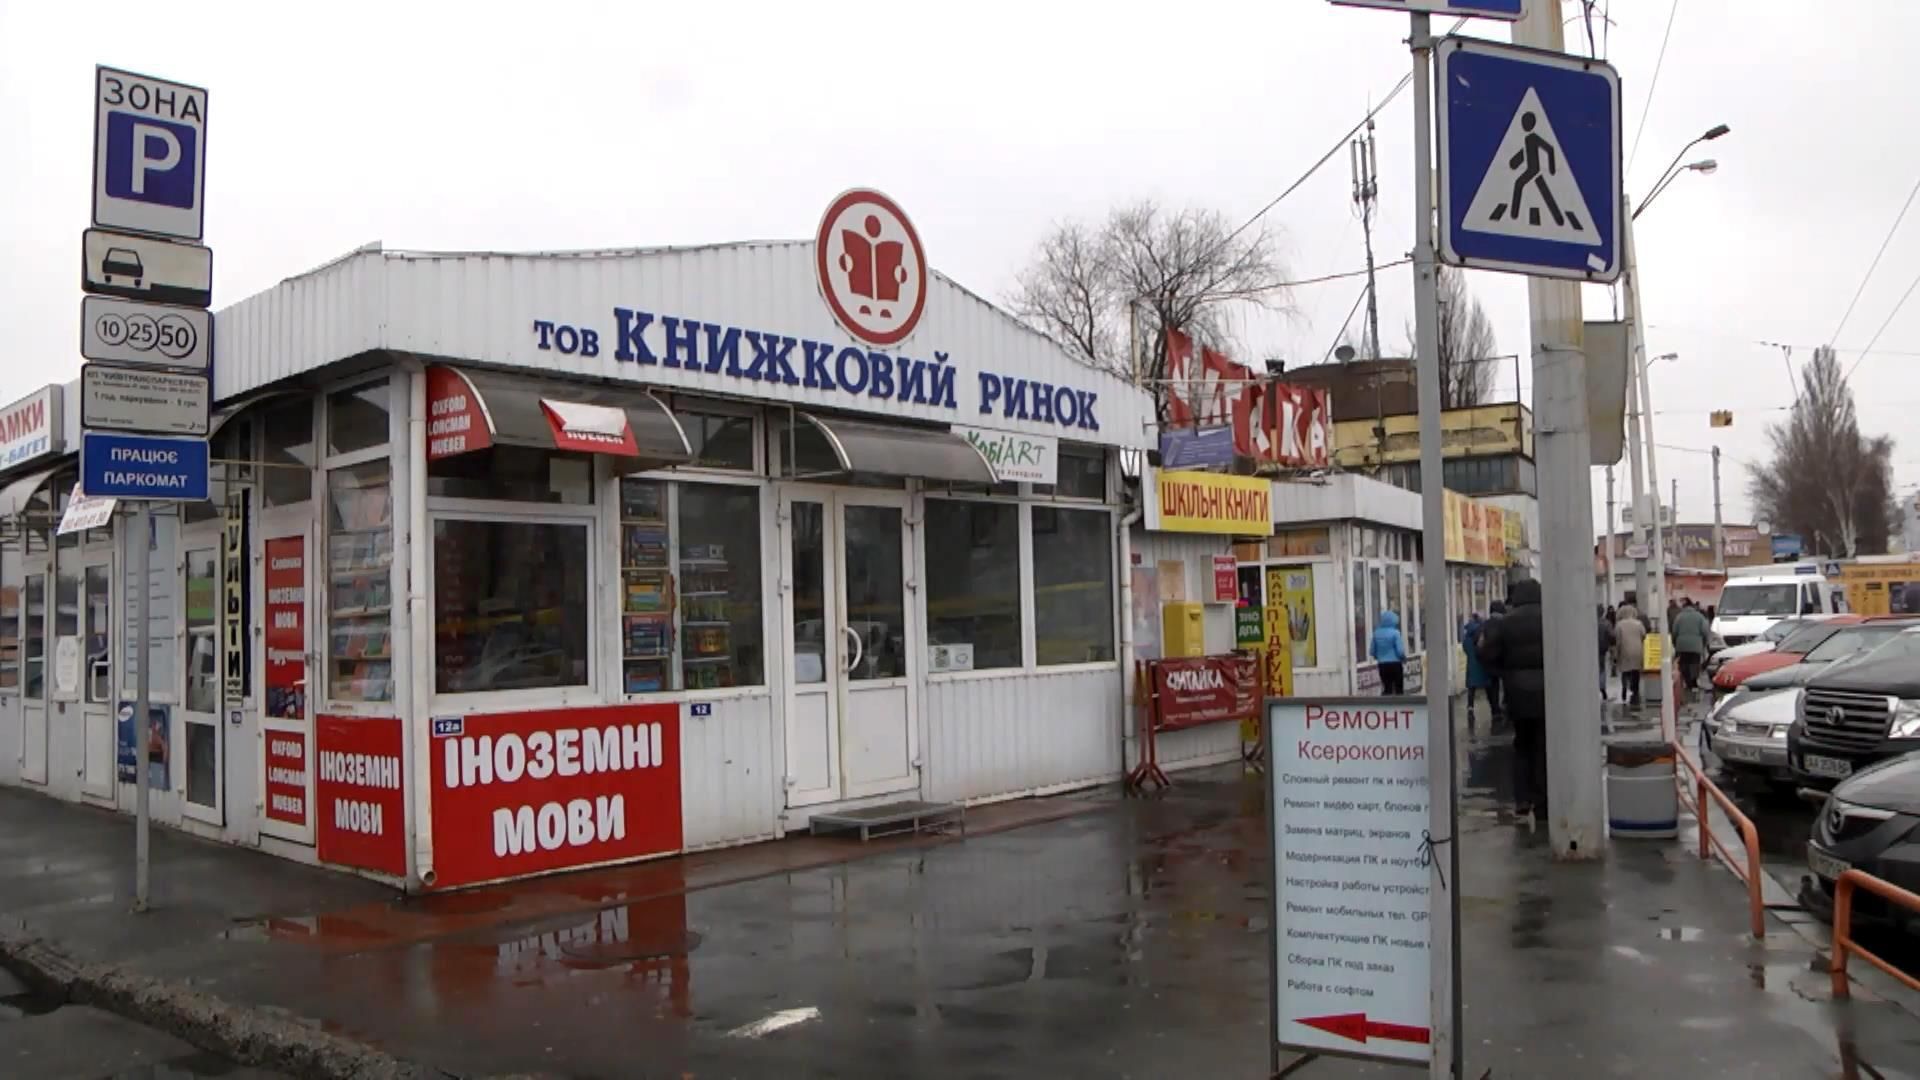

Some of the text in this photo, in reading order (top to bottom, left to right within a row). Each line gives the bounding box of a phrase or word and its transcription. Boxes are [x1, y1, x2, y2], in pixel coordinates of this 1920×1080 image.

[104, 77, 201, 122] ЗОНА
[131, 122, 181, 194] P
[102, 320, 190, 348] 10 25 50
[613, 307, 957, 409] КНИЖКОВИЙ
[978, 370, 1099, 430] РИНОК
[431, 395, 466, 416] OXFORD
[111, 447, 178, 464] ПРАЦЮЄ
[104, 471, 187, 488] ПАРКОМАТ
[1162, 480, 1269, 522] ШКІЛЬНІ КНИГИ
[1305, 703, 1415, 731] Ремонт
[444, 722, 663, 788] ІНОЗЕМНІ
[1297, 741, 1425, 764] Ксерокопия
[320, 750, 400, 789] ІНОЗЕМНІ
[1282, 773, 1330, 785] Сложный
[1331, 775, 1369, 786] ремонт
[1387, 777, 1394, 785] и
[1283, 798, 1320, 809] Ремонт
[1323, 800, 1354, 811] видео
[1384, 801, 1421, 812] блоков
[335, 798, 383, 835] МОВИ
[493, 793, 626, 857] МОВИ
[1285, 824, 1322, 835] Замена
[1368, 829, 1411, 839] экранов
[1286, 851, 1361, 865] Модернизация
[1363, 854, 1378, 865] ПК
[1381, 857, 1388, 865] и
[1286, 876, 1339, 890] Настройка
[1342, 880, 1380, 891] работы
[1286, 901, 1323, 913] Ремонт
[1326, 905, 1384, 919] мобильных
[1287, 928, 1370, 944] Комплектующие
[1372, 935, 1389, 945] ПК
[1390, 938, 1424, 948] новые
[1287, 953, 1395, 973] Сборка ПК под заказ
[1287, 979, 1374, 997] Работа с софтом
